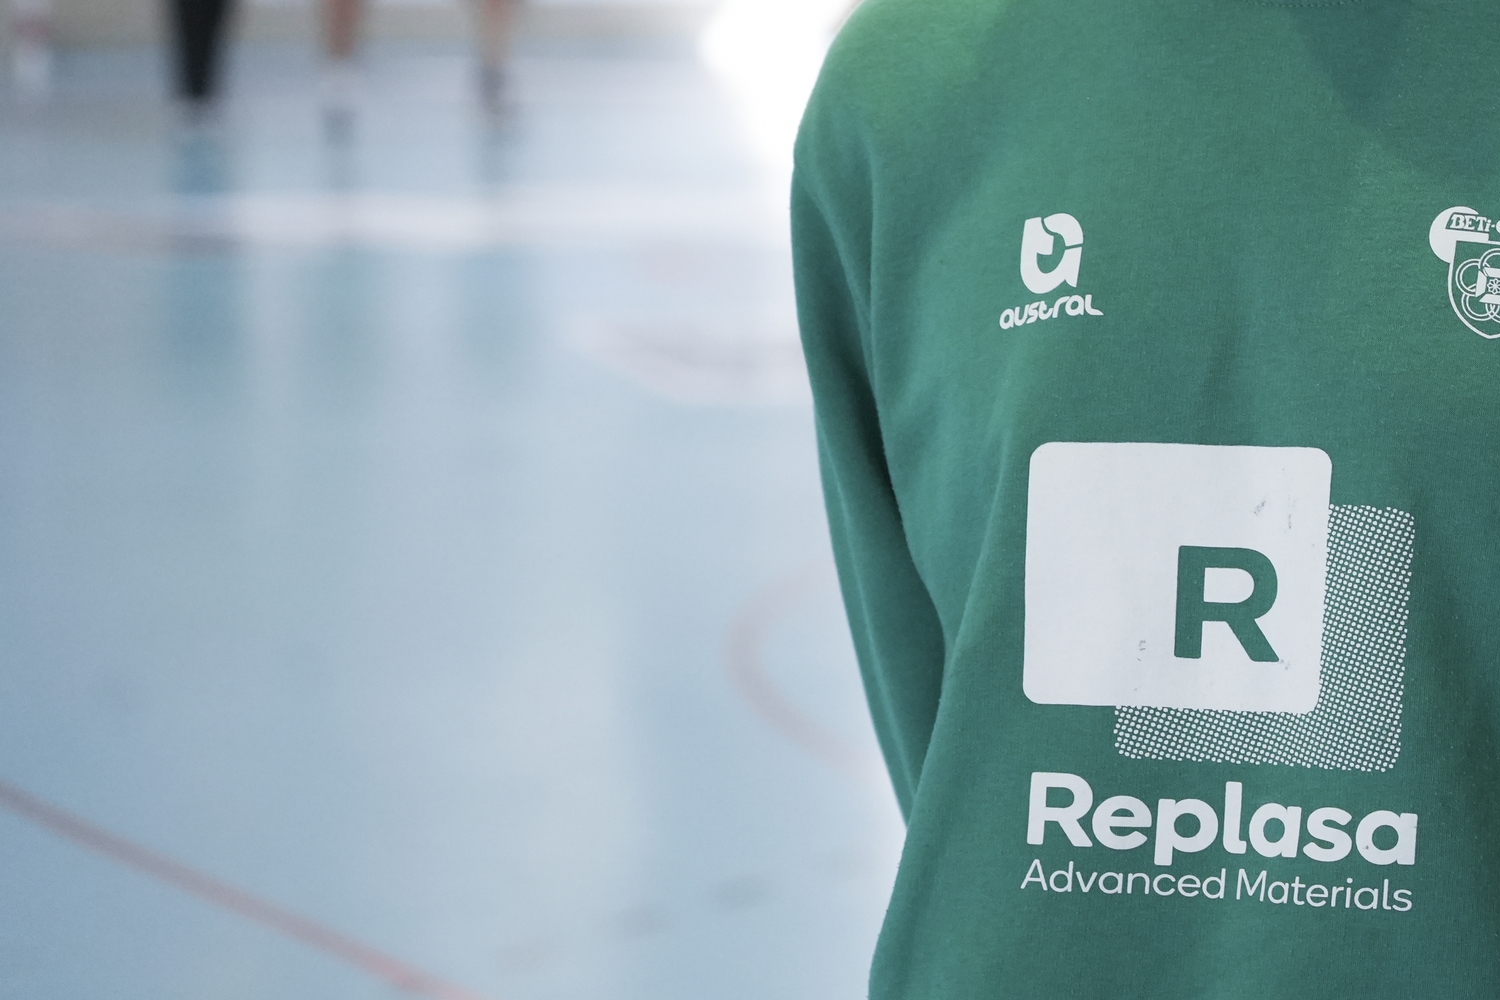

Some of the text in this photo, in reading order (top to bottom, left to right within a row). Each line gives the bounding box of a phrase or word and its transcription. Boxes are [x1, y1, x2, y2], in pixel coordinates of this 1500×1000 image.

[999, 294, 1104, 330] austral
[1173, 544, 1281, 663] R
[1026, 771, 1419, 867] Replasa
[1020, 858, 1413, 912] Advanced Materials
